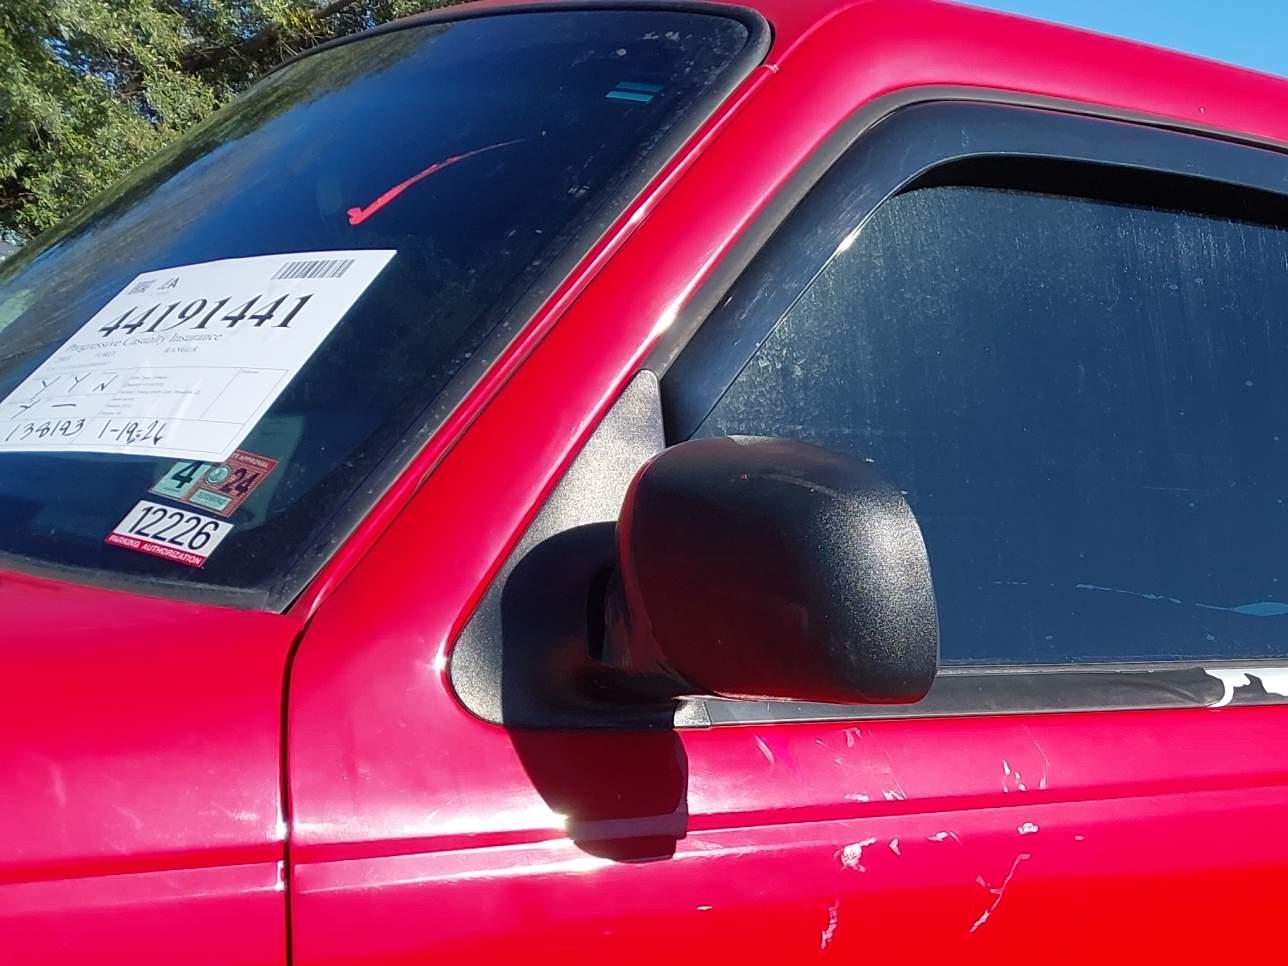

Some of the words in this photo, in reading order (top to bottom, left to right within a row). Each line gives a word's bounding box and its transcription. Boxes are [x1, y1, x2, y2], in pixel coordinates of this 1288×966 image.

[98, 294, 313, 337] 44191441
[170, 462, 203, 489] 4
[219, 467, 259, 497] 24
[127, 506, 220, 550] 12226
[109, 536, 140, 548] PARKING
[142, 543, 201, 564] AUTHORIZATION
